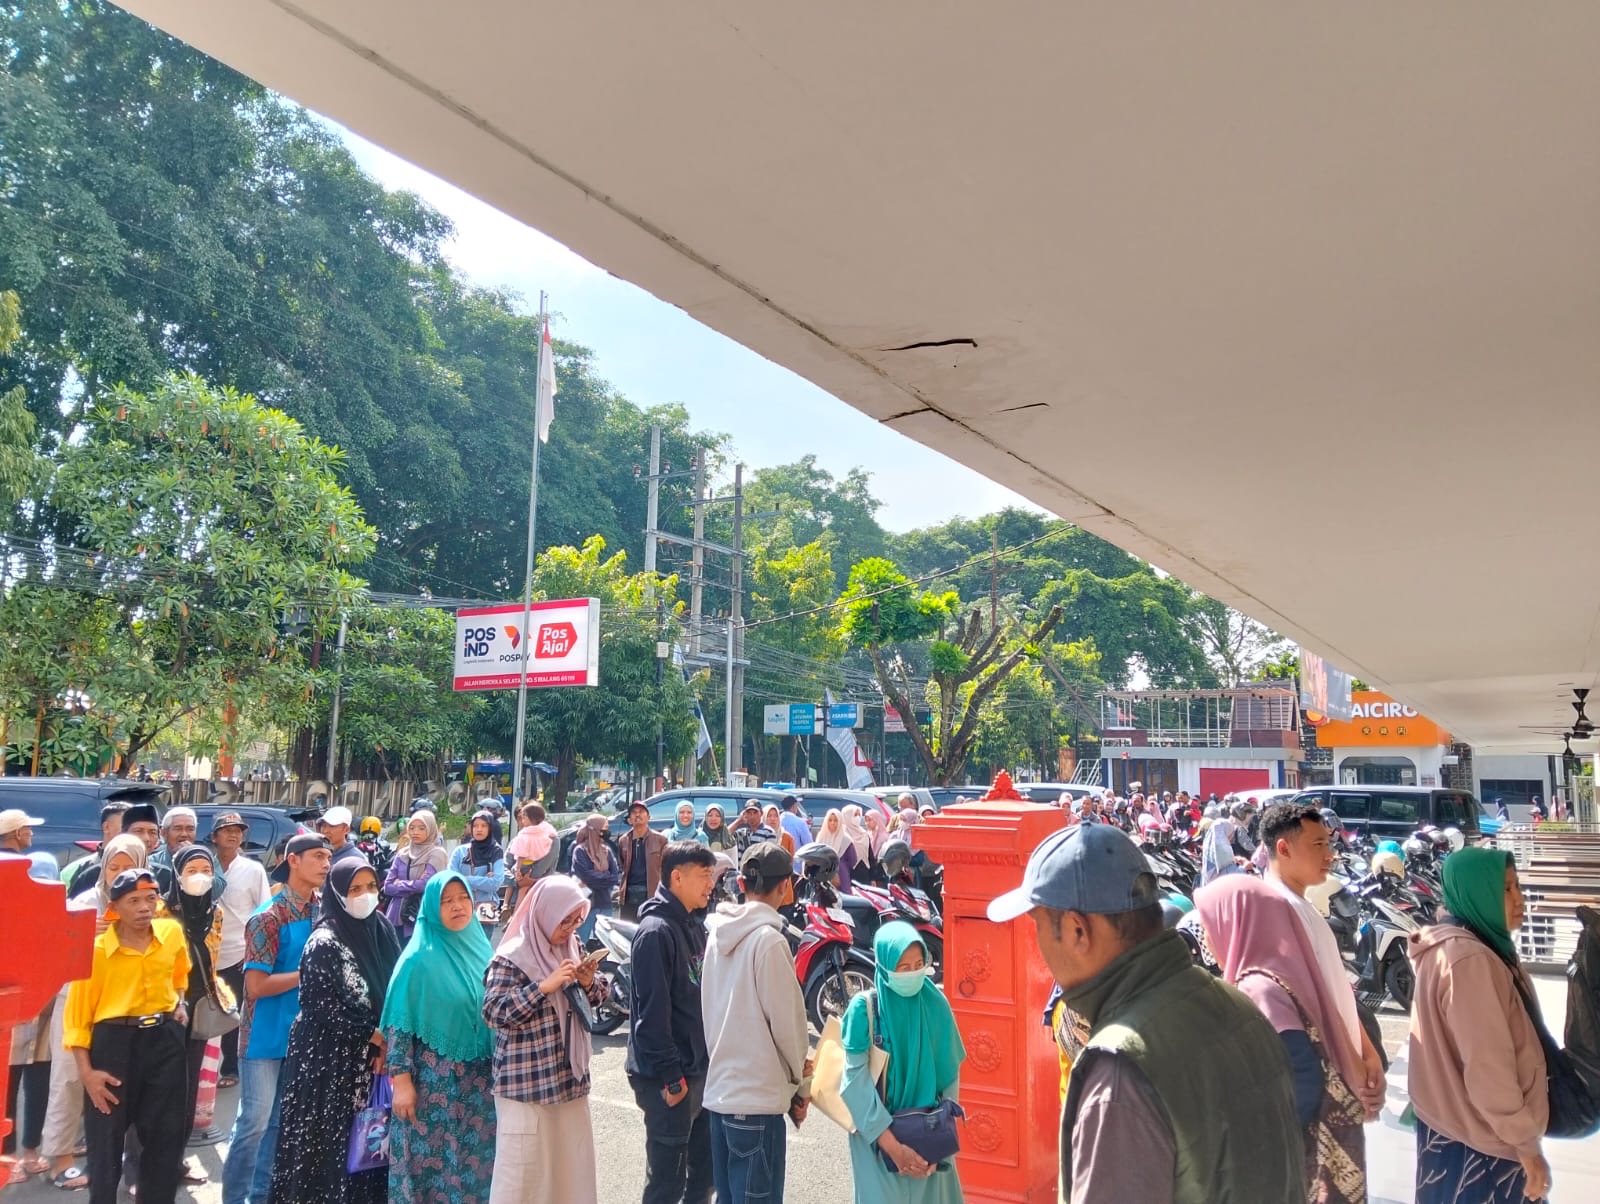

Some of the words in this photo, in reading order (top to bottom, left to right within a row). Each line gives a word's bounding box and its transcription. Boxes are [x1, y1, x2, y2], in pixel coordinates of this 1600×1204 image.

[464, 626, 496, 642] POS
[542, 628, 568, 640] Pos
[542, 640, 568, 656] Aja!
[538, 675, 561, 683] MALANG
